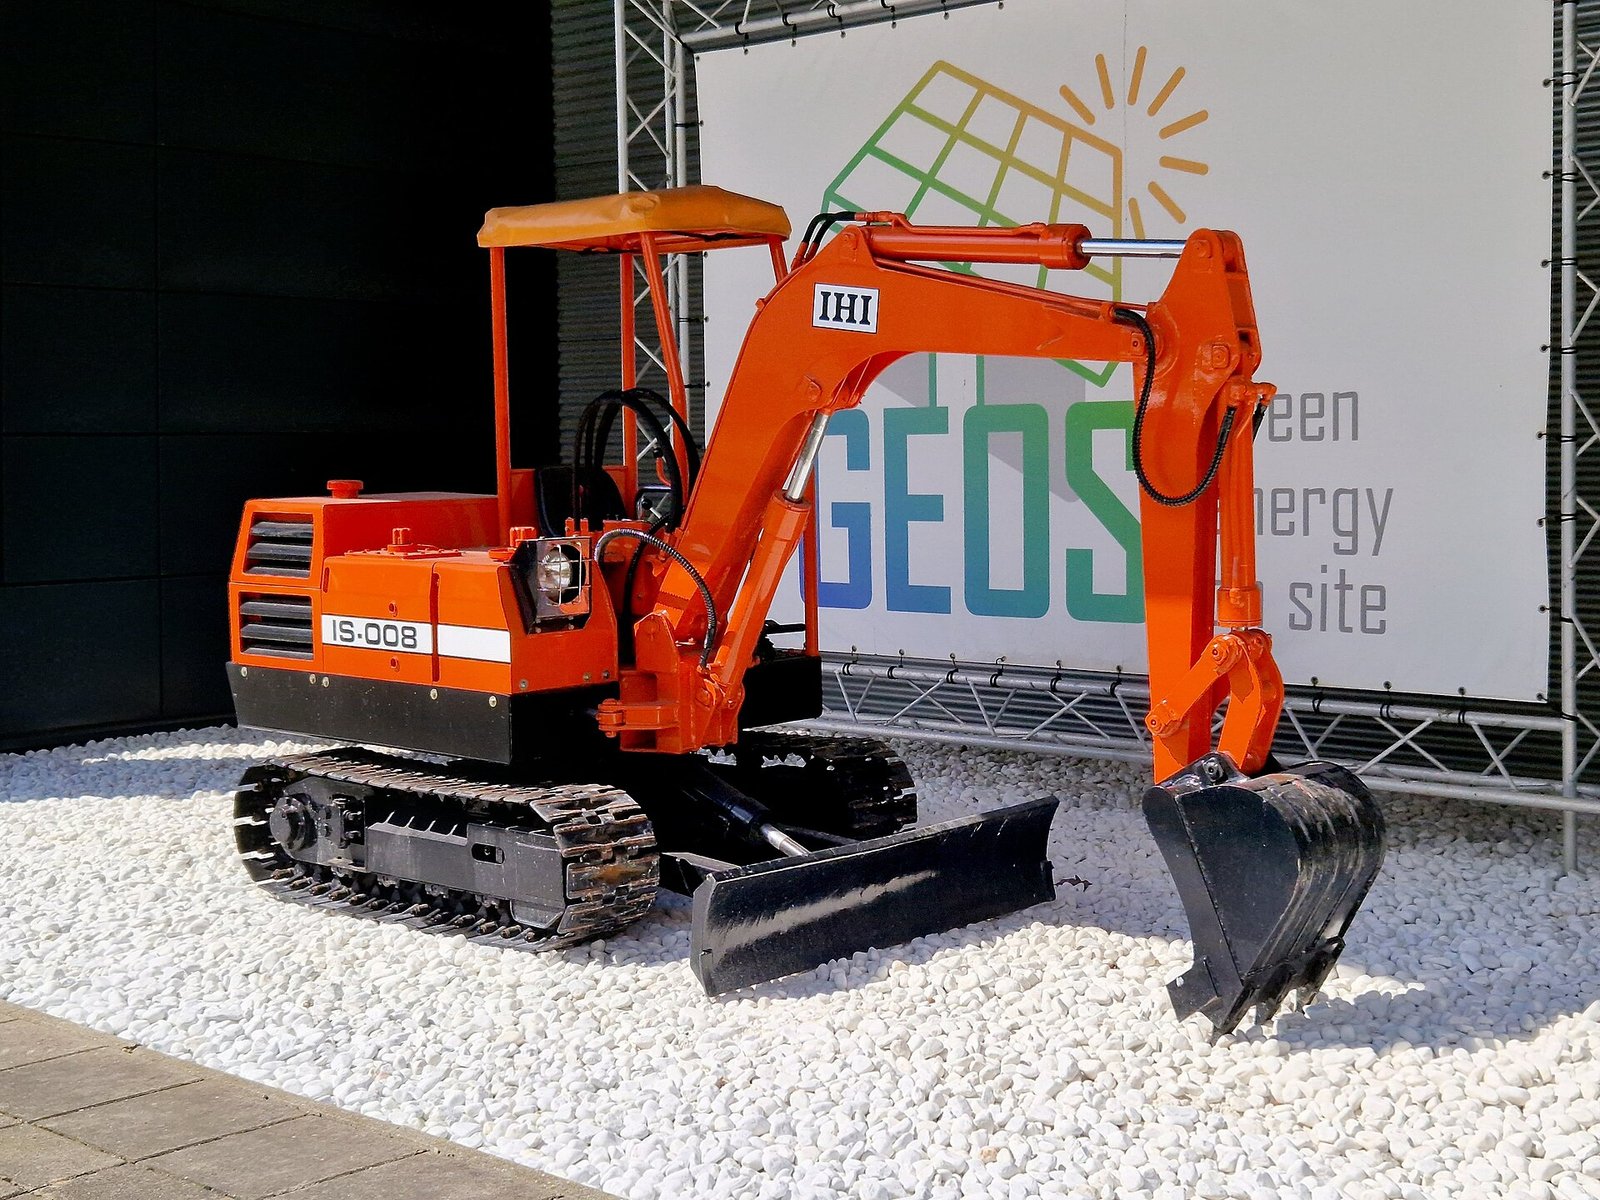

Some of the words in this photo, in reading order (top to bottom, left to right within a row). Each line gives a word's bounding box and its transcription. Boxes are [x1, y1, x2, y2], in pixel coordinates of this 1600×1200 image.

[818, 291, 872, 326] IHI
[1268, 391, 1359, 442] een
[799, 400, 1146, 624] GEOS
[1288, 564, 1387, 635] site
